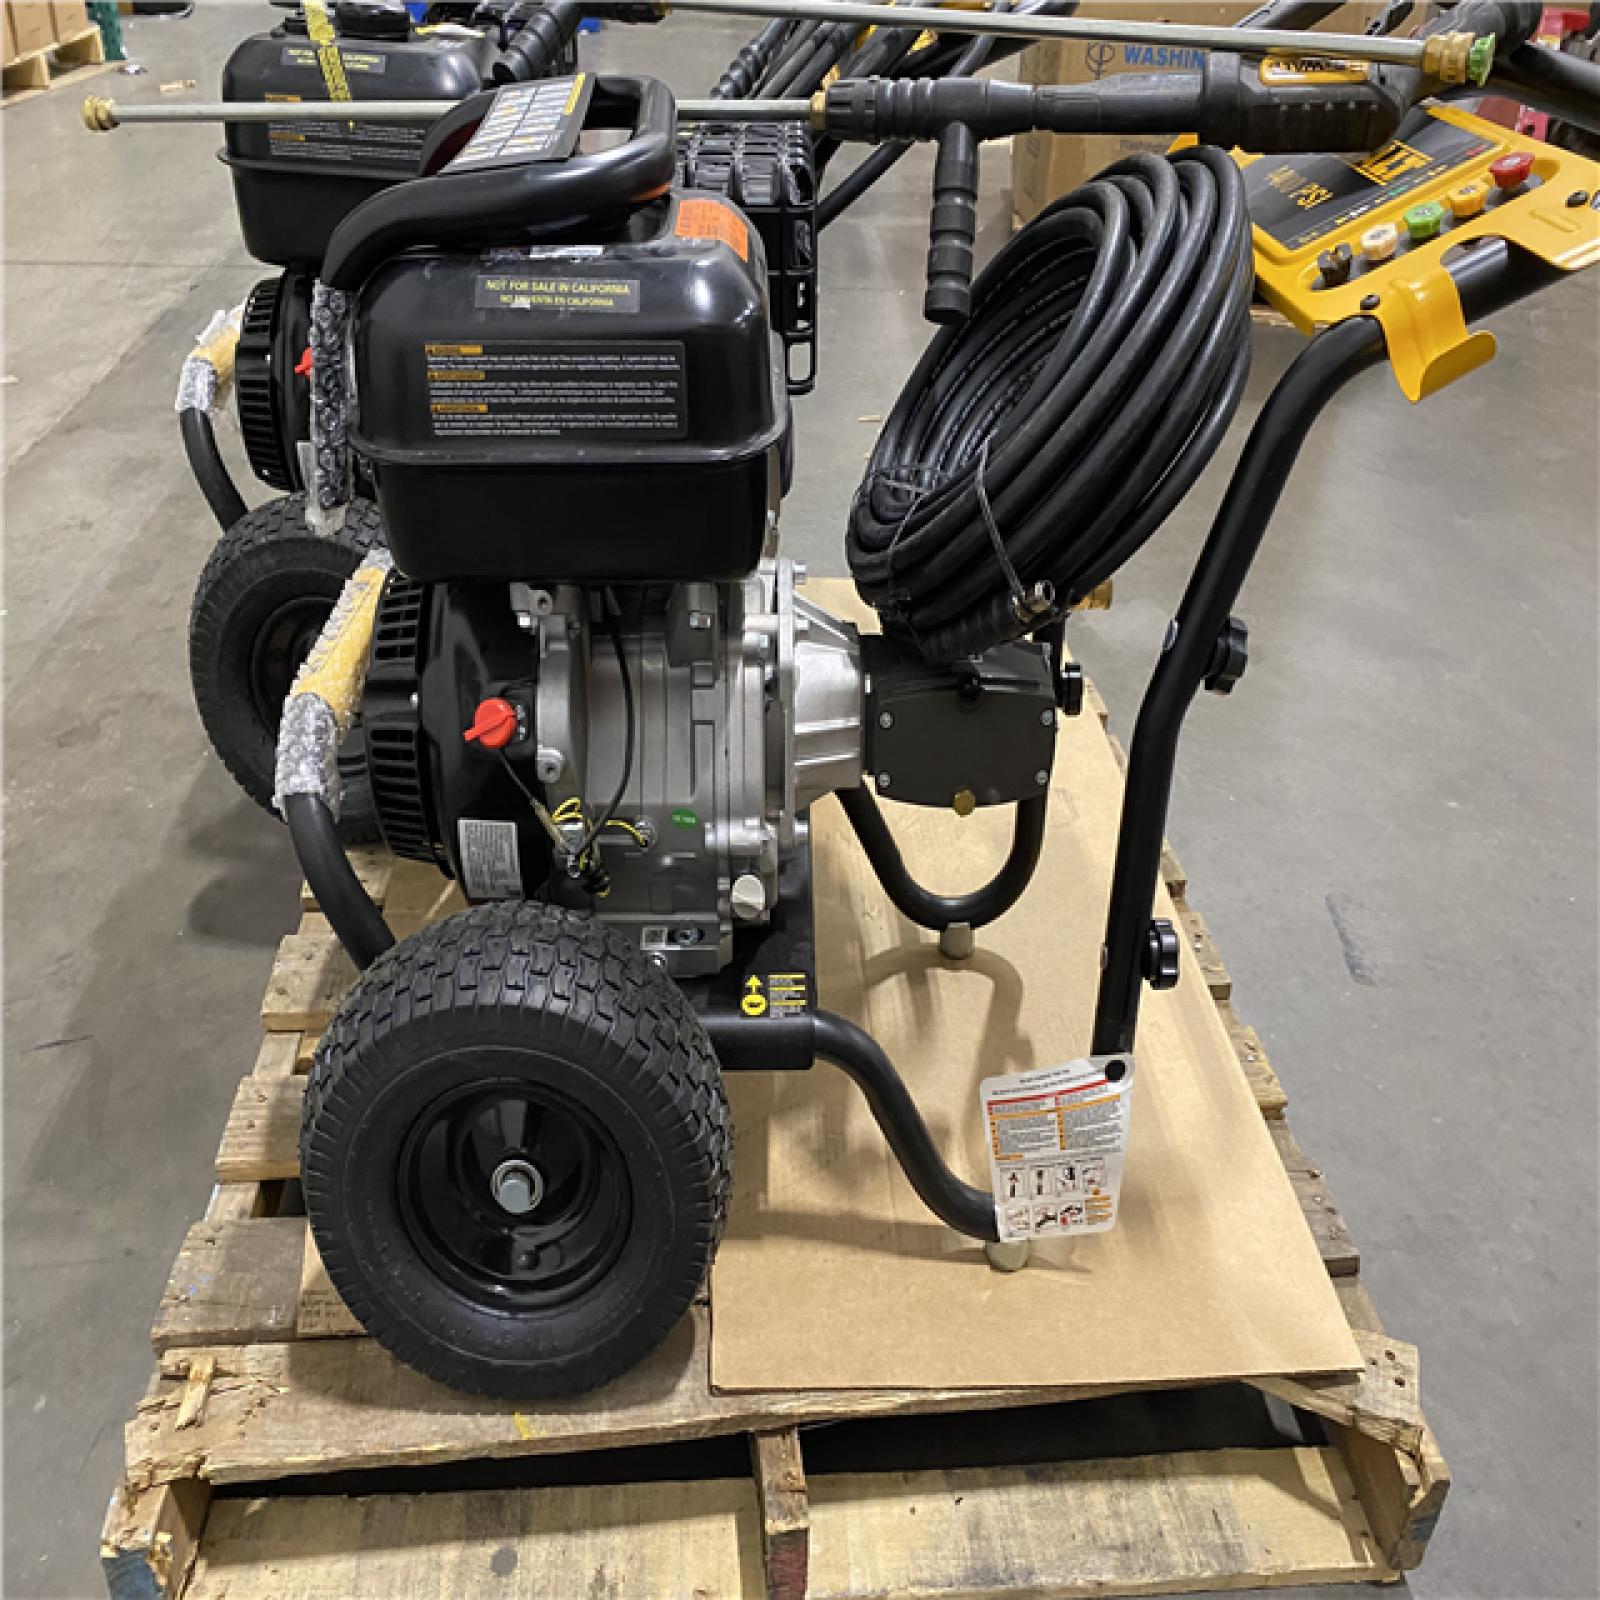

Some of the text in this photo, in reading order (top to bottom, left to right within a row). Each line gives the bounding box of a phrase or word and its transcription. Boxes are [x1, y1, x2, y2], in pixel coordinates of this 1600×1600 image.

[485, 279, 630, 294] NOT FOR SALE IN CALIFORNIA
[567, 297, 614, 306] CALIFORNIA
